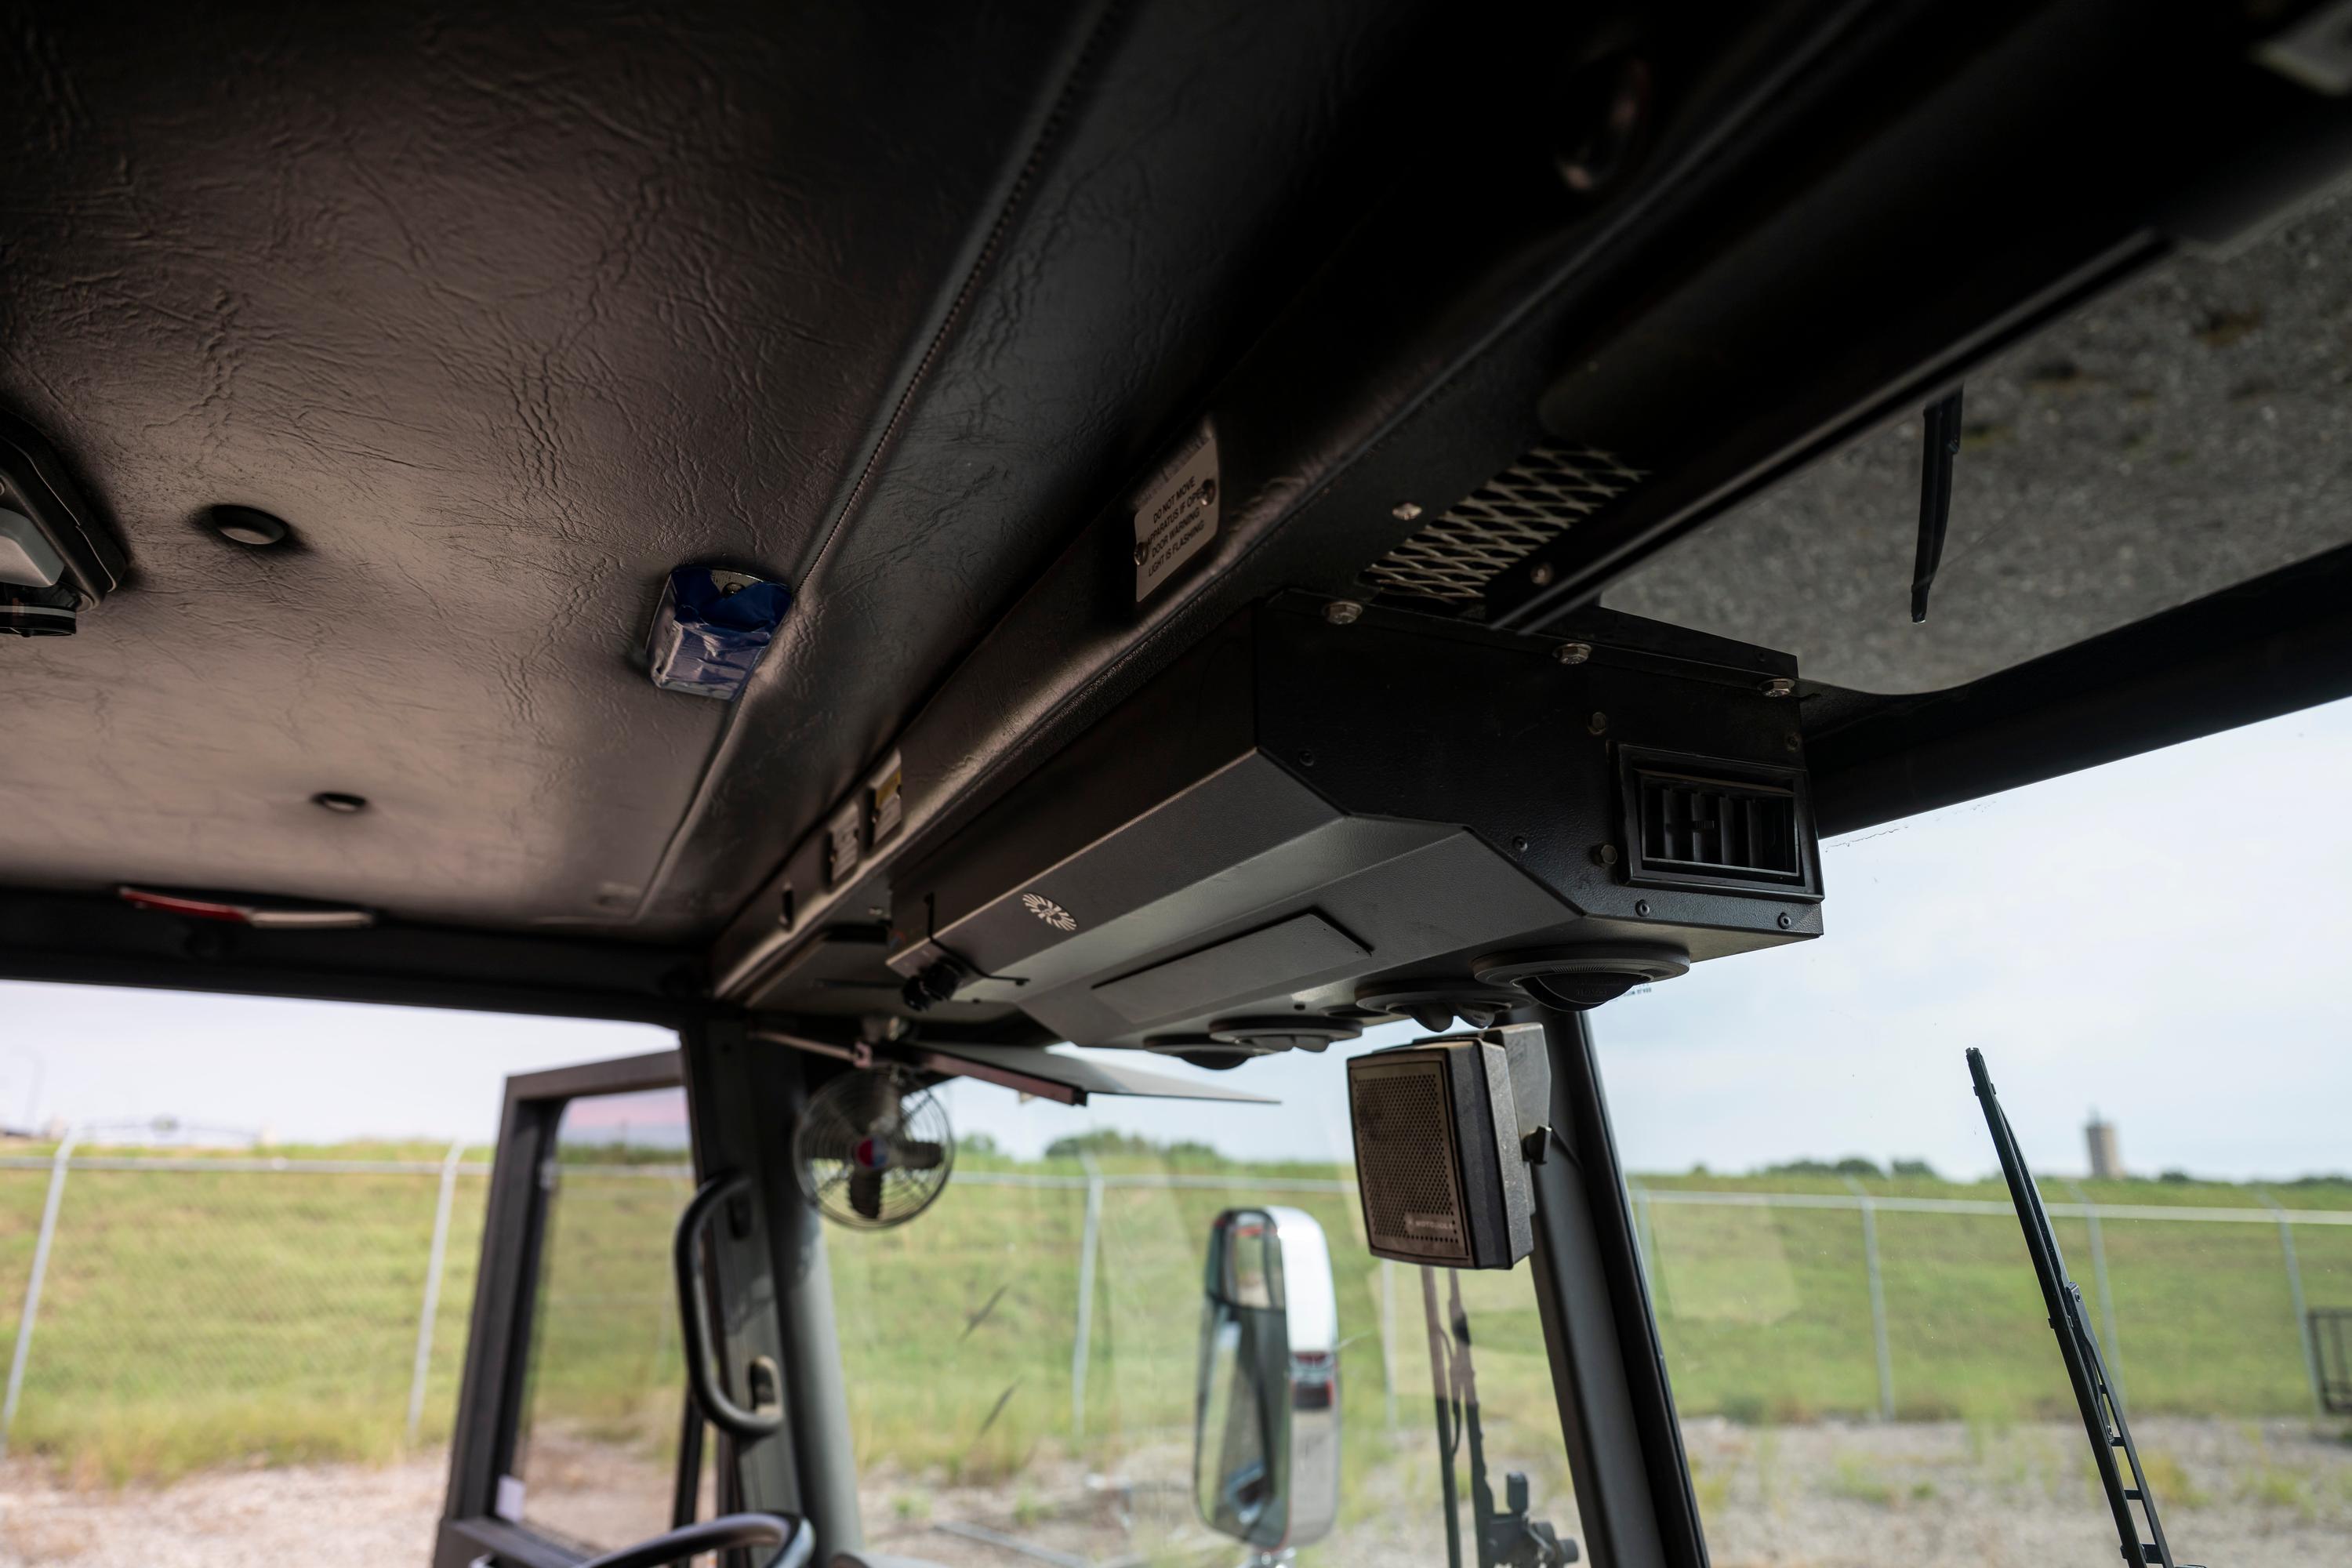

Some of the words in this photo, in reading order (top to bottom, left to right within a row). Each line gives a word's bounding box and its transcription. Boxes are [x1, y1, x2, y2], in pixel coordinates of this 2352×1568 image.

[1154, 509, 1161, 523] DO
[1163, 495, 1175, 514] NOT
[1177, 476, 1195, 500] MOVE
[1147, 508, 1178, 546] APPARATUS
[1180, 502, 1185, 514] IF
[1152, 535, 1168, 557] DOOR
[1170, 507, 1200, 540] WARNING
[1149, 554, 1164, 577] LIGHT
[1166, 548, 1171, 560] IS
[1173, 520, 1204, 554] FLASHING
